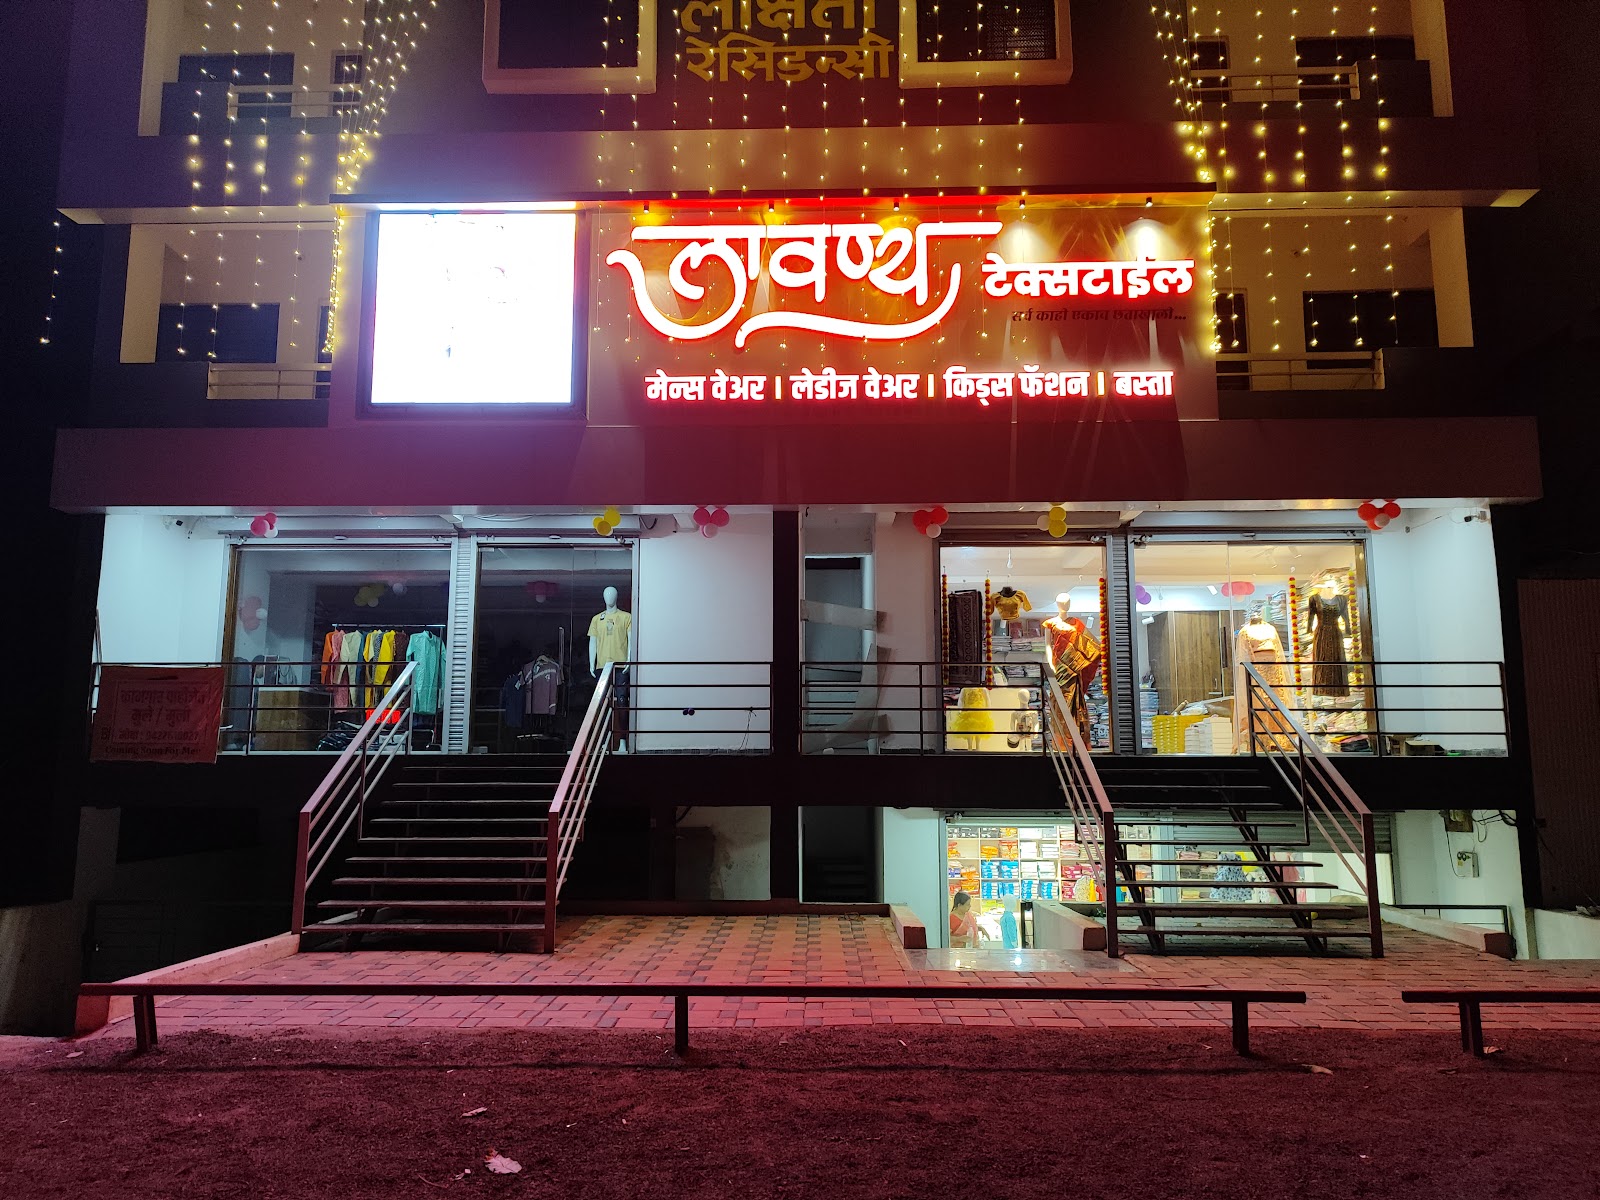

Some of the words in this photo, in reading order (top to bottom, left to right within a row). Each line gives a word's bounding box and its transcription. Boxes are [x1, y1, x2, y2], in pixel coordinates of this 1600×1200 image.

[981, 252, 1194, 298] टेक्सटाईल
[645, 368, 706, 400] मेन्स
[710, 368, 767, 400] वेअर
[789, 367, 859, 399] लेडीज
[862, 366, 920, 398] वेअर
[943, 365, 1015, 406] किड्स
[1018, 364, 1090, 397] फॅशन
[1113, 371, 1174, 396] बस्ता
